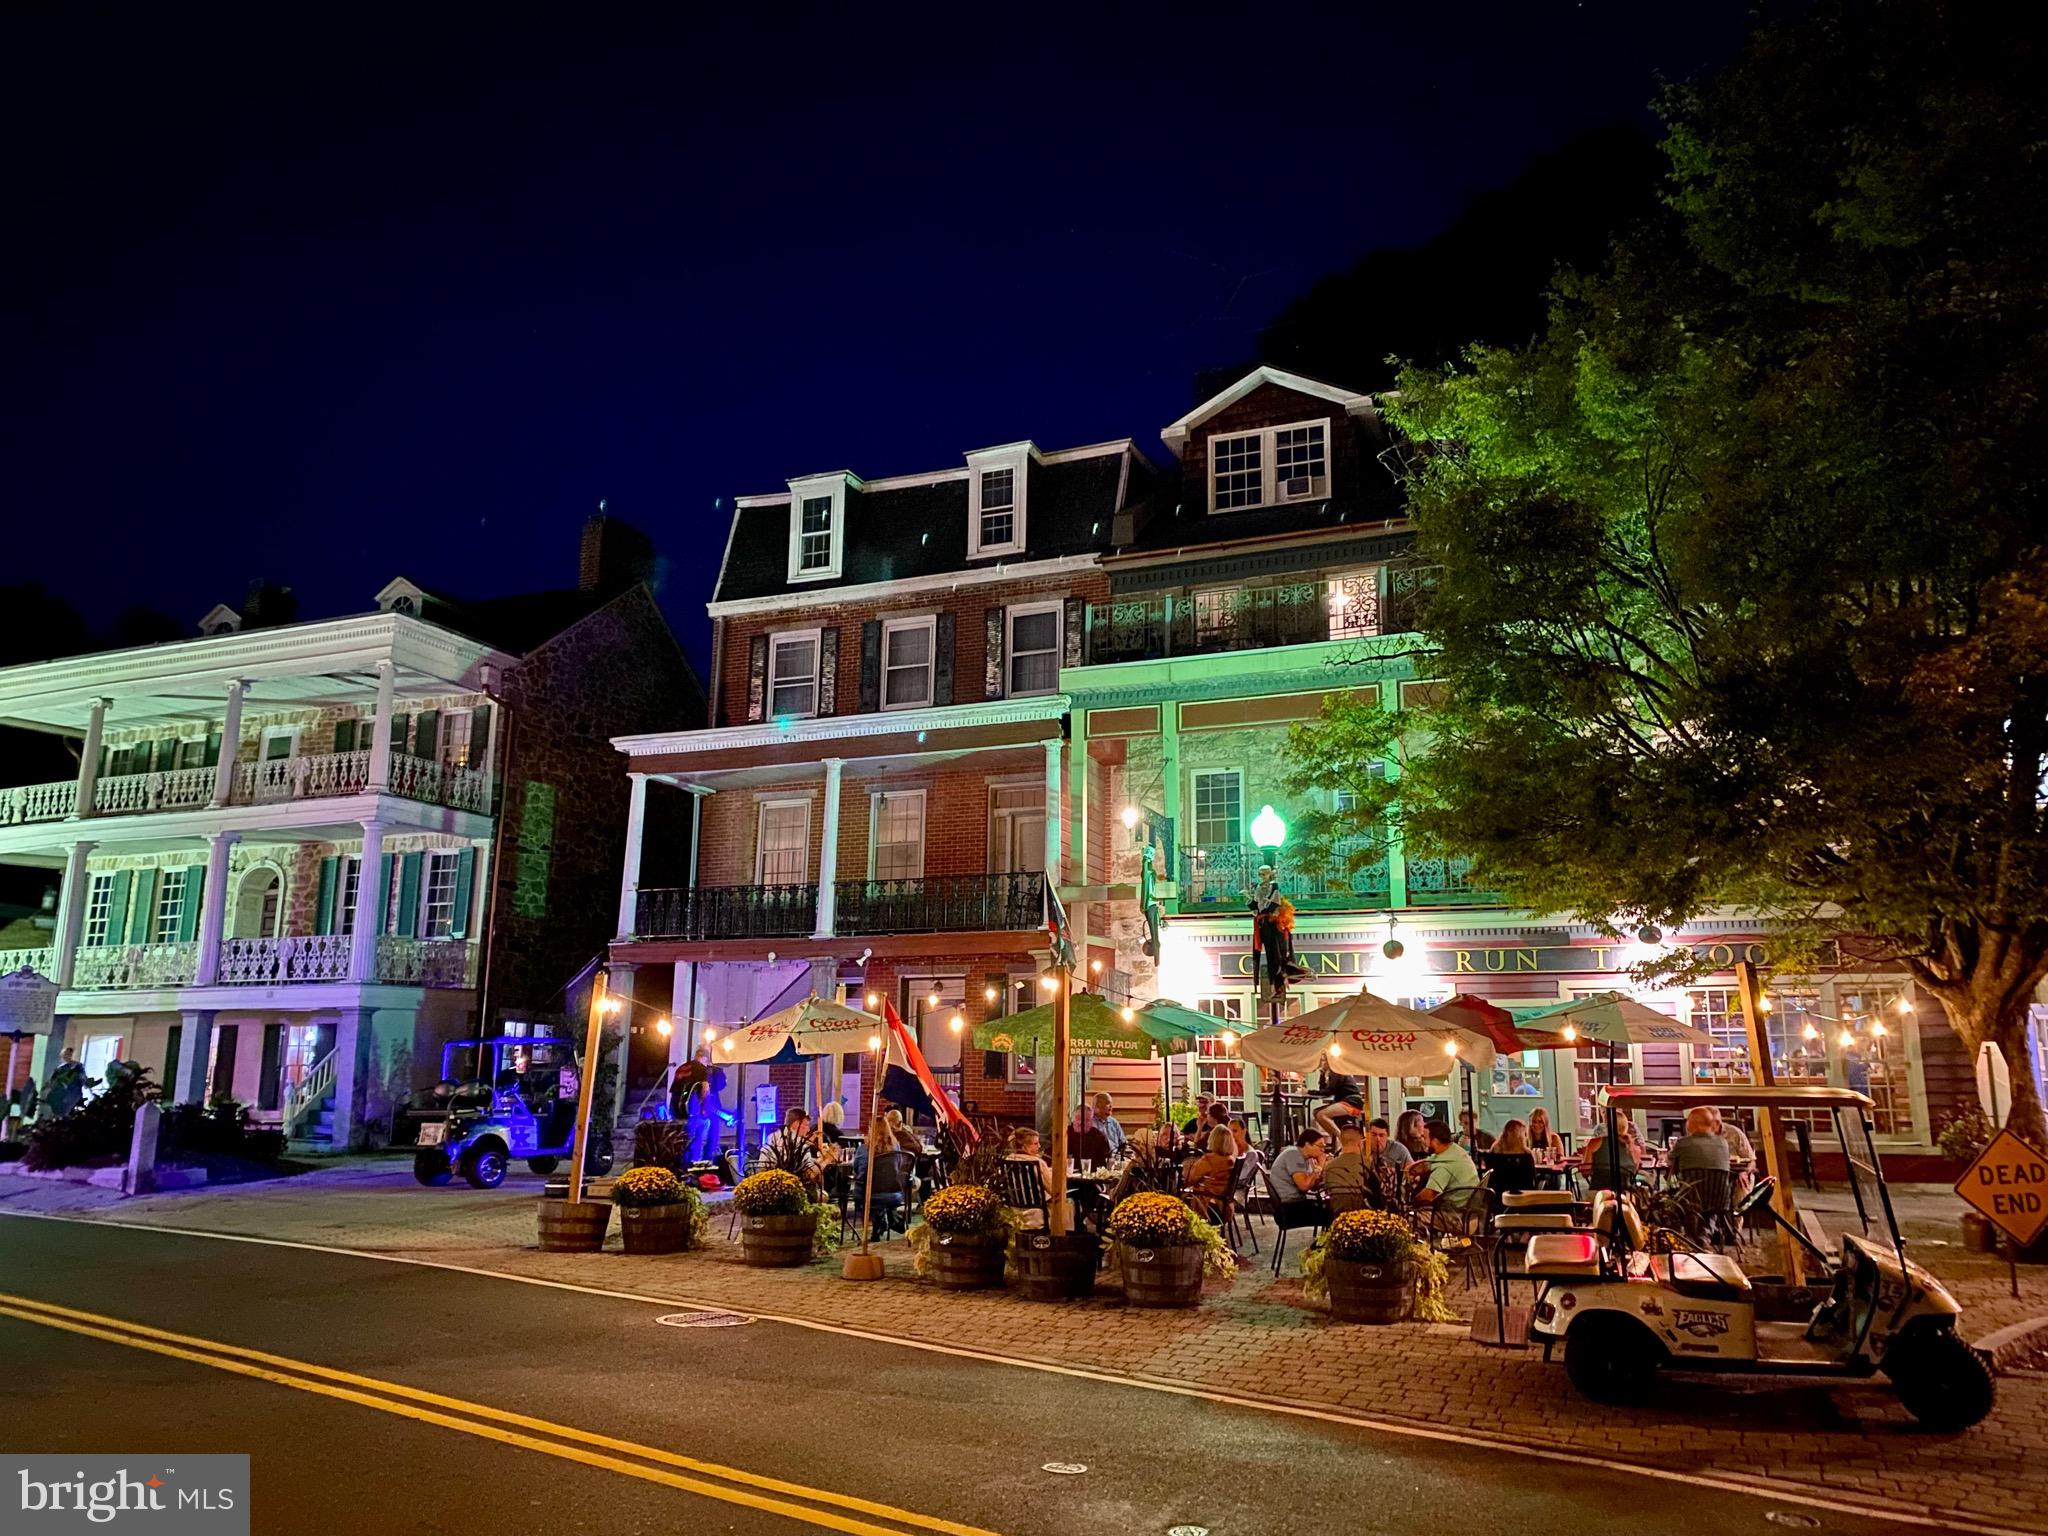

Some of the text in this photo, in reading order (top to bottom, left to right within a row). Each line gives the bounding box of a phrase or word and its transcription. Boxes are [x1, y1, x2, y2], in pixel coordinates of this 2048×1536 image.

[1455, 949, 1538, 971] RUN
[1096, 1040, 1138, 1050] NEVADA
[1352, 1029, 1417, 1043] Coors
[1361, 1042, 1413, 1051] LIGHT
[1979, 1163, 2045, 1186] DEAD
[1992, 1193, 2041, 1215] END
[1677, 1311, 1727, 1330] EAGLES
